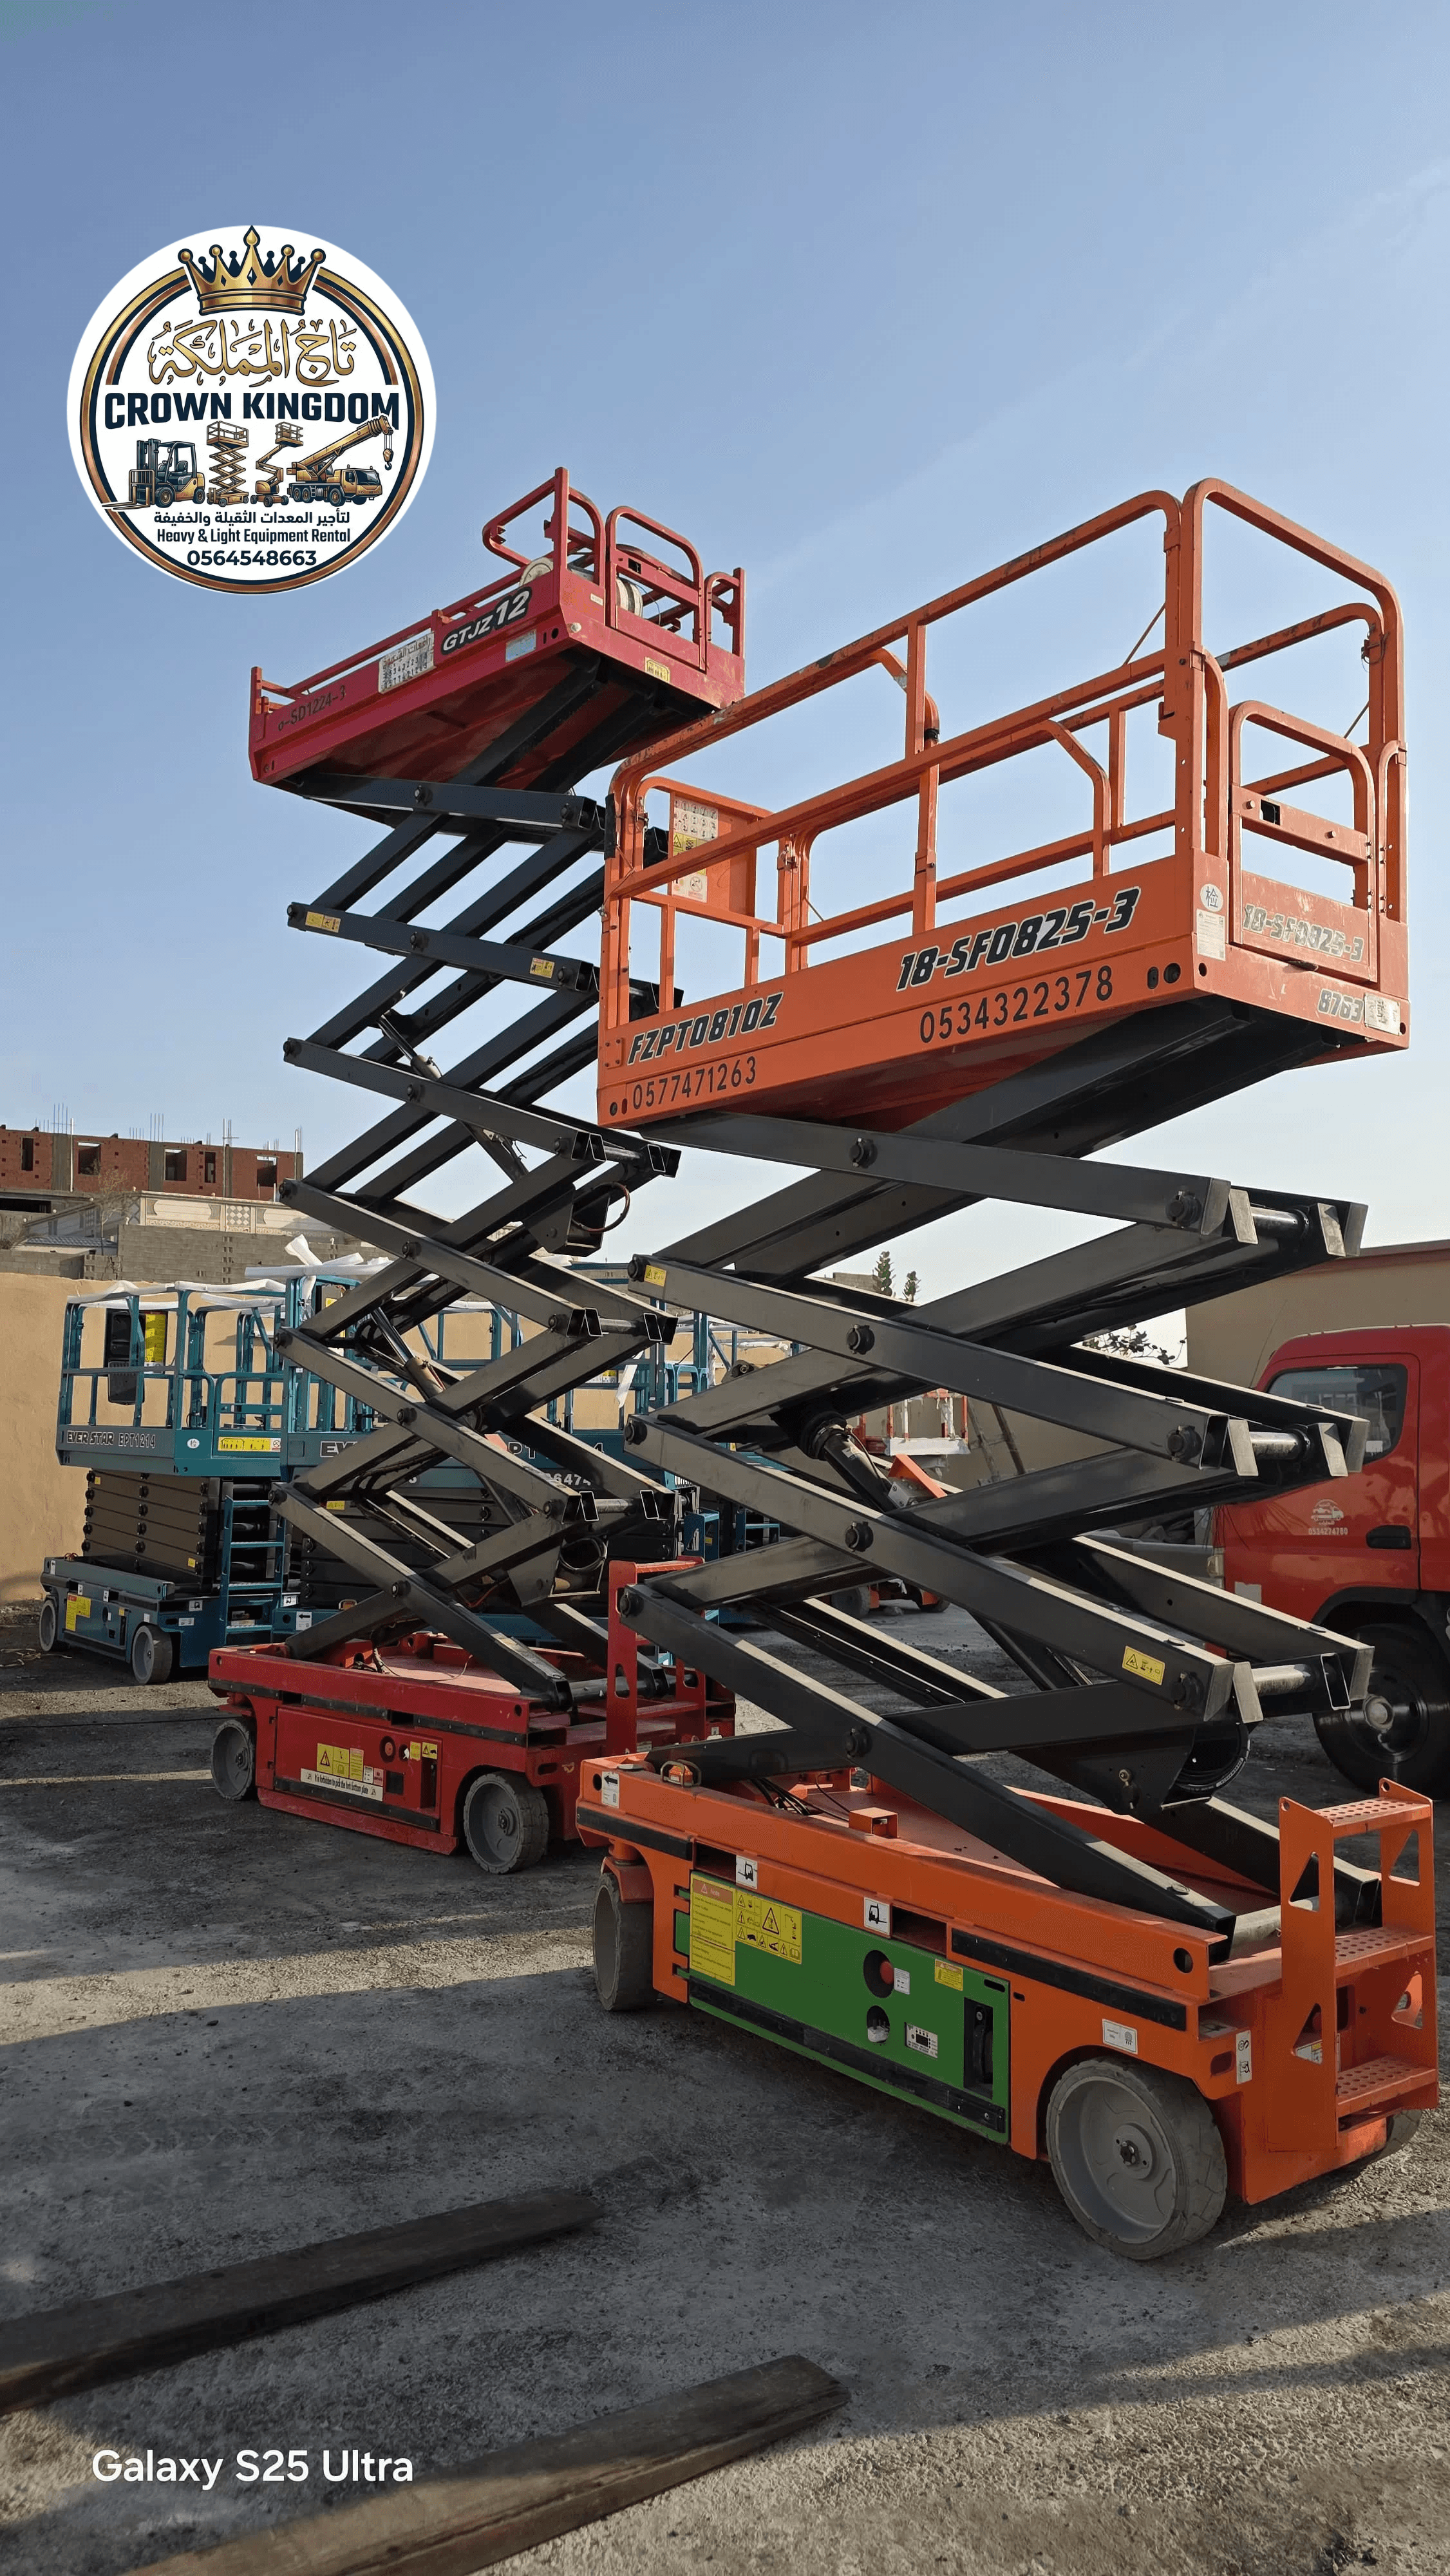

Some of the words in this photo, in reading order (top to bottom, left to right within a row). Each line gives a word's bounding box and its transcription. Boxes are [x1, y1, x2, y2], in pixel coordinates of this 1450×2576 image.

[896, 886, 1141, 992] 18-SF0825-3
[627, 992, 784, 1065] FZPT0810Z
[920, 965, 1113, 1043] 0534322378
[633, 1056, 756, 1109] 0577471263
[67, 1430, 88, 1444] EVER
[89, 1431, 114, 1445] STAR
